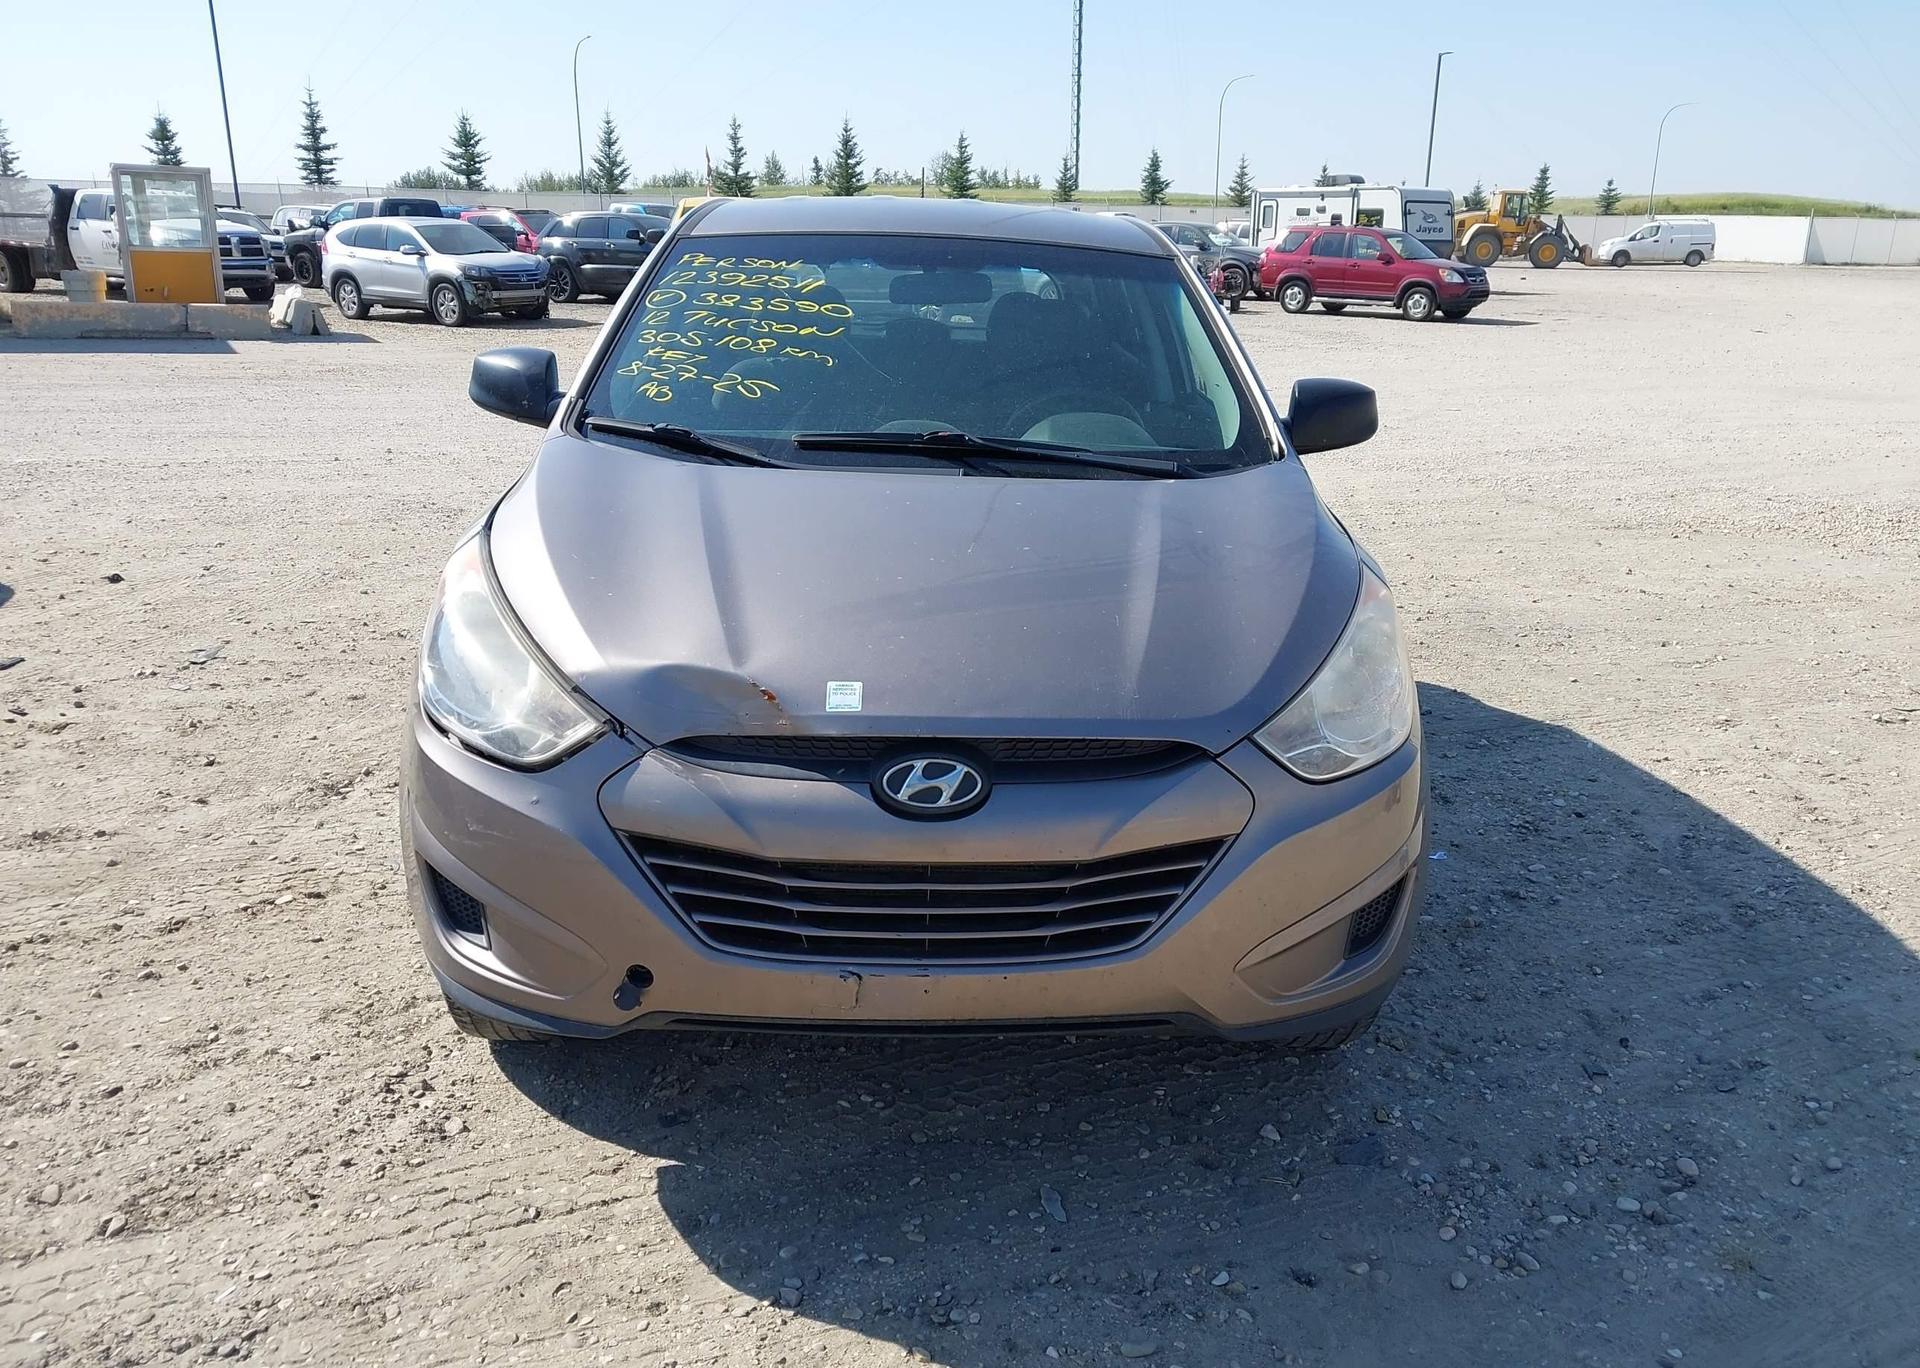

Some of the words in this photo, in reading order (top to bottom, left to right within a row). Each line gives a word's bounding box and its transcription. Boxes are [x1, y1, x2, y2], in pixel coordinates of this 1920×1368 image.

[1415, 225, 1444, 234] Jayco
[677, 253, 803, 268] PERSON
[642, 311, 670, 325] 12
[683, 311, 845, 336] TUCSON
[617, 361, 781, 398] 8-27-25
[636, 381, 673, 401] AB
